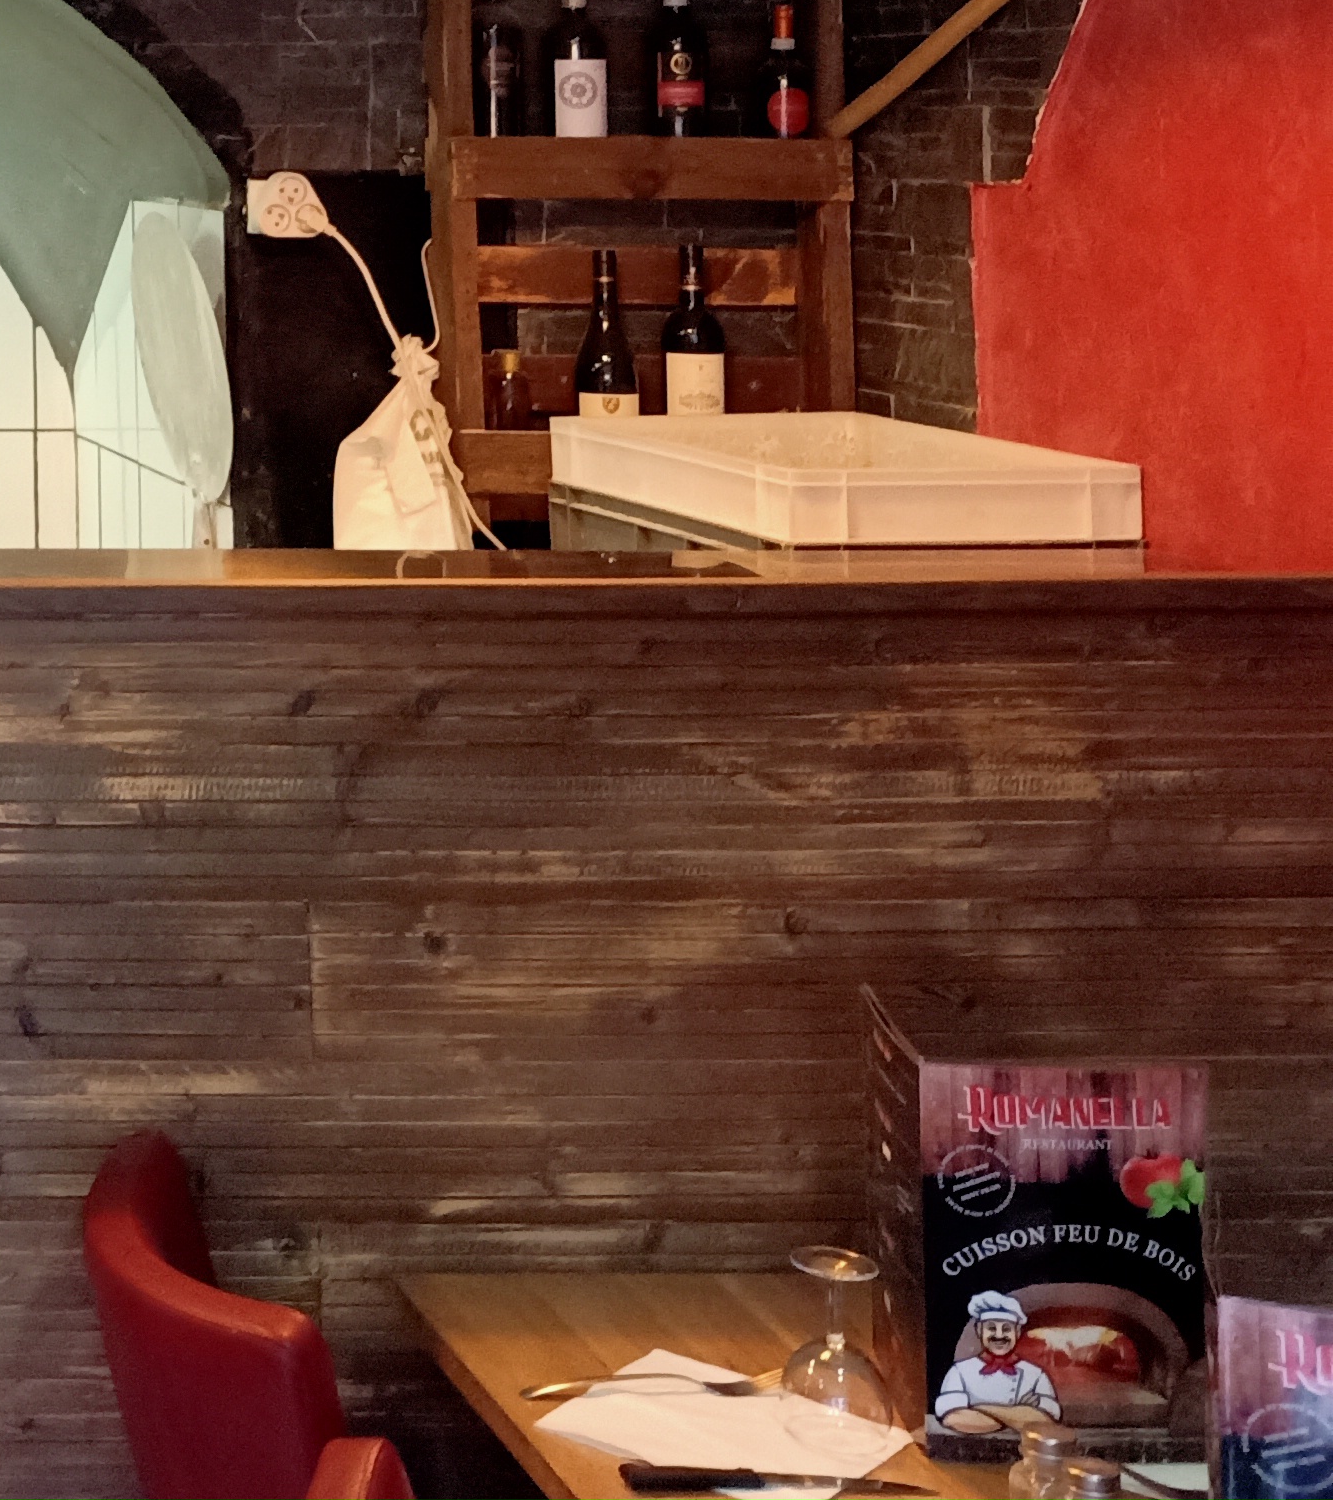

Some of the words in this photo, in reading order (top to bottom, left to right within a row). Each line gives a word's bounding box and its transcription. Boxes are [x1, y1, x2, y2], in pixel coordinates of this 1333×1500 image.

[957, 1084, 1173, 1136] ROMANELLA
[1023, 1138, 1113, 1150] RESTAURANT
[942, 1225, 1046, 1276] CUISSON
[1053, 1224, 1101, 1244] FEU
[1106, 1227, 1140, 1252] DE
[1142, 1239, 1197, 1282] BOIS
[1268, 1328, 1333, 1396] RO
